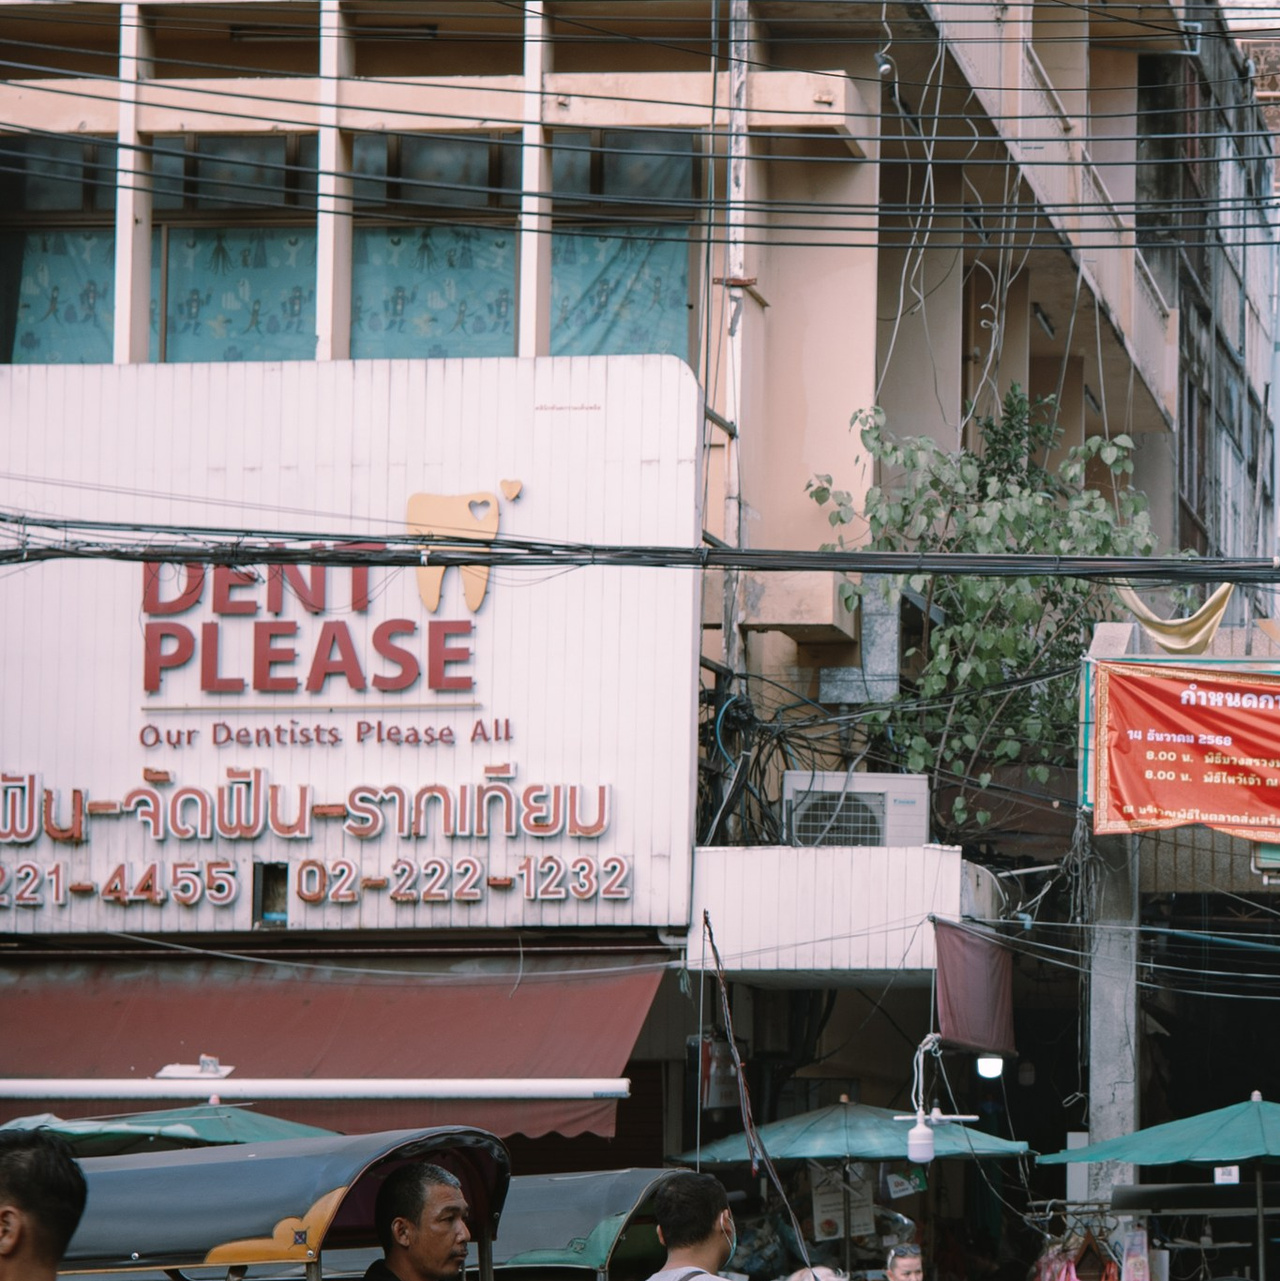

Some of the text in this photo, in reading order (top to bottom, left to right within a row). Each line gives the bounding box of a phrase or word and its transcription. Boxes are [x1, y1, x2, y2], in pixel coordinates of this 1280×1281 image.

[143, 542, 388, 614] DENT
[143, 618, 474, 693] PLEASE
[139, 718, 514, 748] Our Dentists Please All
[1126, 728, 1232, 747] 14 ธันวาคม 2568
[1145, 750, 1177, 762] 8.00
[1144, 769, 1176, 781] 8.00
[0, 855, 631, 907] 21-4455 02-222-1232
